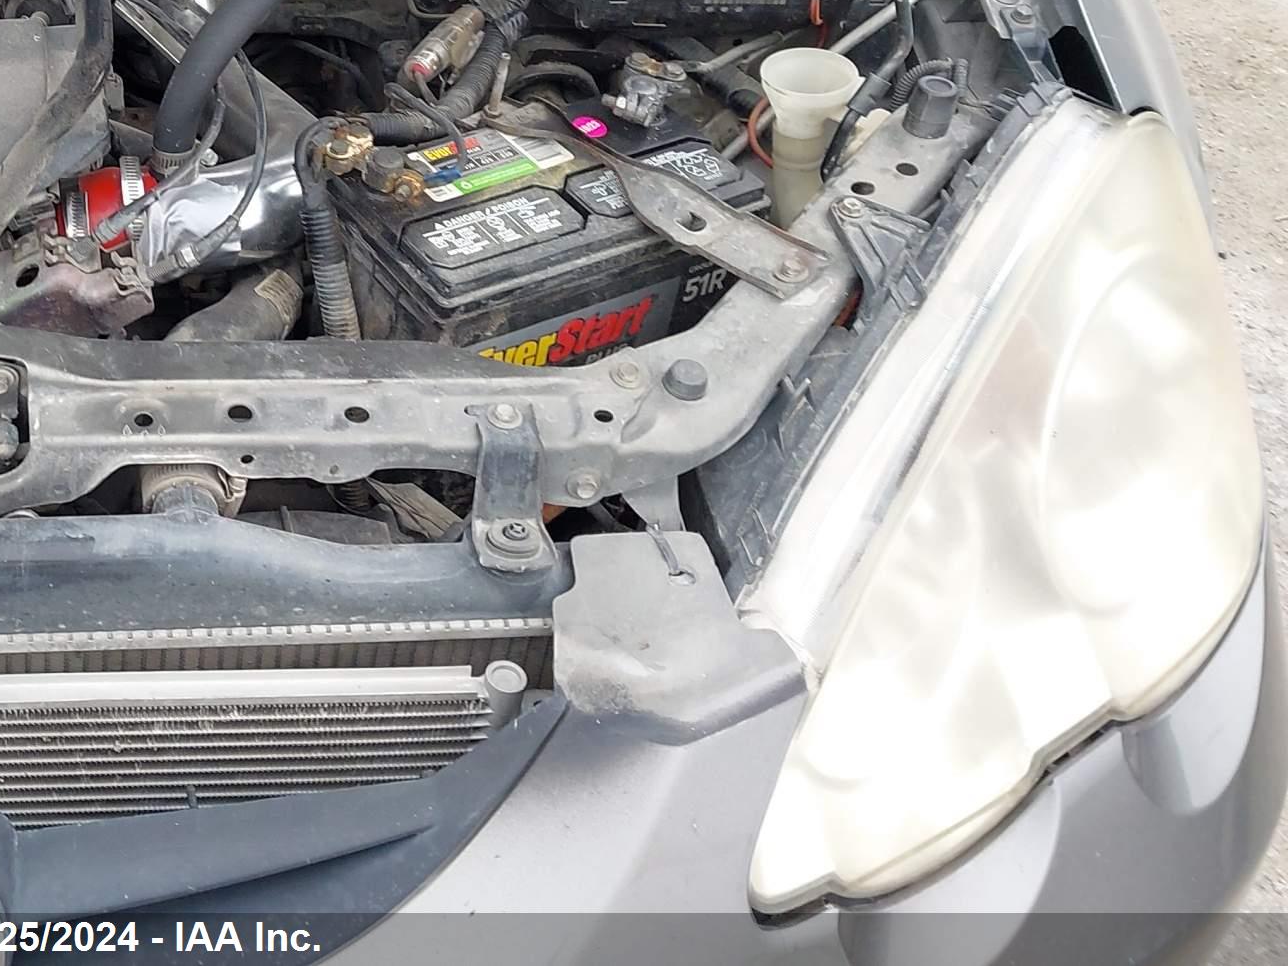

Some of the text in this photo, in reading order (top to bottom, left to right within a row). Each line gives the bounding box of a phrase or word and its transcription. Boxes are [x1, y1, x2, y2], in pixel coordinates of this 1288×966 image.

[443, 210, 487, 227] DANGER
[491, 196, 530, 214] POISON
[682, 268, 727, 302] 51R
[478, 296, 654, 367] verStart
